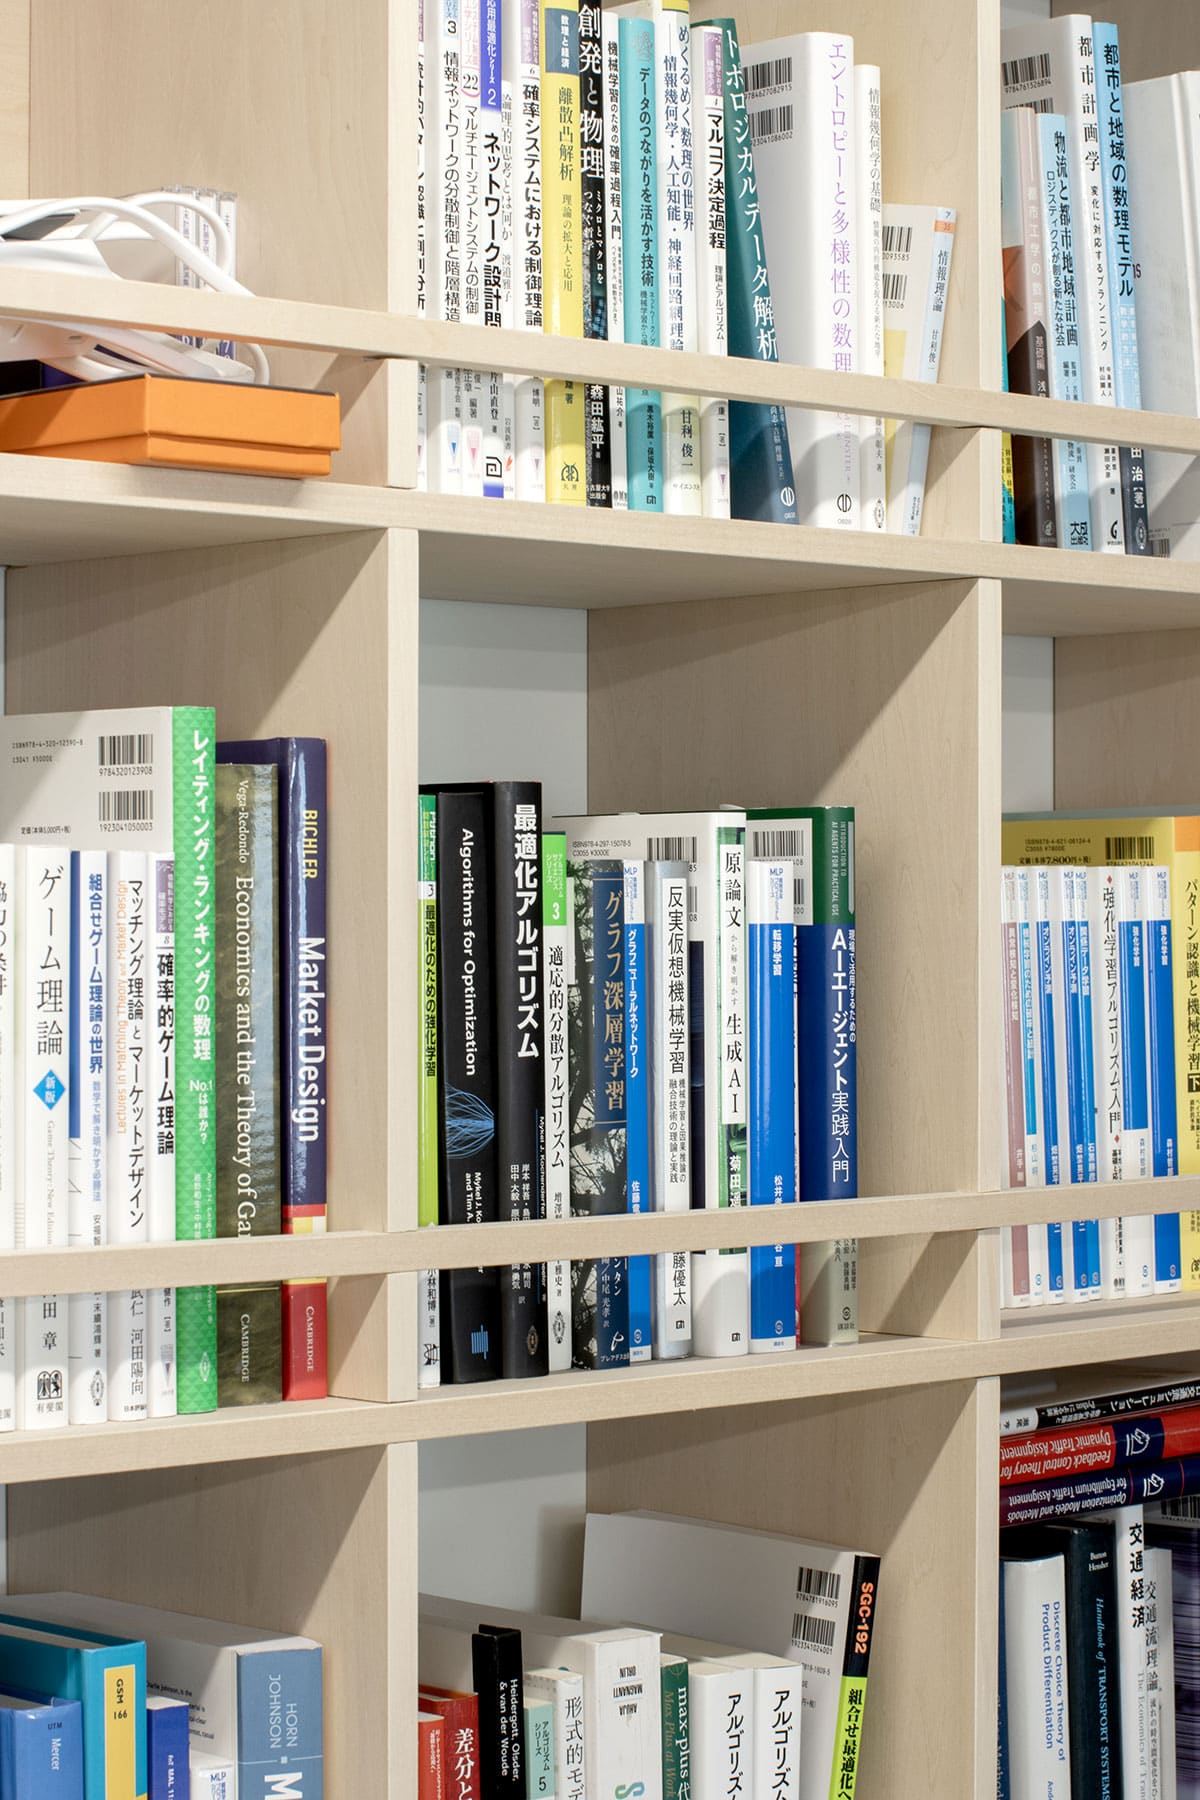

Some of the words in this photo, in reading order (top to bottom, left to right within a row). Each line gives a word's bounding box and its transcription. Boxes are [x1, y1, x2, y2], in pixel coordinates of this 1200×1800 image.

[447, 20, 457, 34] 3
[463, 74, 479, 90] 22
[487, 89, 497, 106] 2
[578, 5, 604, 180] 創発と物理
[1079, 36, 1100, 172] 都市計画学
[558, 87, 574, 181] 離散凸解析
[607, 41, 623, 240] 機械学習のための確率過程入門
[679, 26, 694, 232] めくるめく数理の世界
[443, 50, 461, 322] 情報ネットワークの分散制御と階層構造
[639, 68, 656, 287] データのつながりを活かす技術
[707, 113, 726, 249] マルコフ決定過程
[726, 29, 779, 362] トポロジカルデータ解析
[1103, 43, 1134, 297] 都市と地域の数理モデル
[464, 104, 480, 315] マルチエージェントシステムの制御
[829, 43, 851, 372] エントロピーと多様性の数理
[1055, 131, 1078, 348] 物流と都市地域計画
[99, 766, 153, 777] 9784320123908
[99, 822, 153, 833] 1923041050003
[236, 779, 250, 864] Vega-Redondo
[304, 810, 319, 879] BICHLER
[192, 730, 211, 1061] レイティング・ランキングの数理
[459, 828, 475, 928] Algorithms
[725, 852, 741, 928] 原論文
[236, 876, 255, 997] Economics
[514, 804, 540, 1060] 最適化アルゴリズム
[552, 902, 560, 920] 3
[37, 865, 64, 1056] ゲーム理論
[462, 931, 476, 957] for
[88, 874, 104, 1074] 組合せゲーム理論の世界
[297, 937, 326, 1038] Market
[604, 891, 625, 1111] グラフ深層学習
[668, 886, 686, 1074] 反実仮想機械学習
[236, 1003, 256, 1045] and
[462, 960, 479, 1076] Optimization
[628, 929, 639, 1079] グラフニューラルネットワーク
[128, 881, 144, 1228] マッチング理論とマーケットデザイン
[157, 953, 175, 1155] 確率的ゲーム理論
[236, 1050, 256, 1086] the
[549, 946, 565, 1169] 適応的分散アルゴリズム
[726, 1014, 743, 1114] 生成AI
[831, 928, 849, 1183] AIエージェント実践入門
[291, 1046, 326, 1143] Design
[232, 1089, 257, 1168] Theory
[237, 1173, 257, 1200] of
[43, 1331, 57, 1351] 章
[241, 1313, 250, 1383] CAMBRIDGE
[305, 1305, 315, 1372] CAMBRIDGE
[1000, 1441, 1049, 1462] Assignment
[1042, 1456, 1073, 1473] Control
[1050, 1436, 1076, 1452] Traffic
[1072, 1450, 1111, 1467] Feedback
[1079, 1431, 1111, 1449] Dynamic
[1008, 1489, 1051, 1507] Assignment
[1013, 1461, 1043, 1478] Theory
[1050, 1486, 1075, 1500] Traffic
[1075, 1480, 1116, 1496] Equilibrium
[1115, 1477, 1128, 1490] for
[1007, 1507, 1039, 1522] Methods
[1038, 1505, 1054, 1516] and
[1054, 1500, 1081, 1513] Models
[1081, 1493, 1127, 1511] Optimization
[1130, 1523, 1145, 1630] 交通経済
[854, 1582, 874, 1655] SGC-192
[1042, 1603, 1051, 1653] Product
[1053, 1601, 1061, 1652] Discrete
[1096, 1597, 1105, 1649] Handbook
[1144, 1581, 1159, 1692] 交通流理論
[116, 1678, 124, 1705] GSM
[499, 1681, 508, 1691] &
[612, 1684, 643, 1698] MAGNANTI
[1044, 1656, 1054, 1750] Differentiation
[1054, 1656, 1063, 1698] Choice
[113, 1710, 128, 1721] 166
[268, 1674, 281, 1750] JOHNSON
[285, 1703, 298, 1748] HORN
[500, 1717, 509, 1735] der
[510, 1678, 519, 1741] Heidergott,
[618, 1703, 638, 1717] AHUJA
[1056, 1700, 1064, 1745] Theory
[1098, 1667, 1109, 1746] TRANSPORT
[51, 1738, 61, 1772] Mercer
[501, 1737, 510, 1777] Woude
[512, 1743, 521, 1782] Olsder,
[538, 1775, 547, 1792] 5
[1058, 1747, 1066, 1762] of
[1100, 1746, 1111, 1800] SYSTEMS
